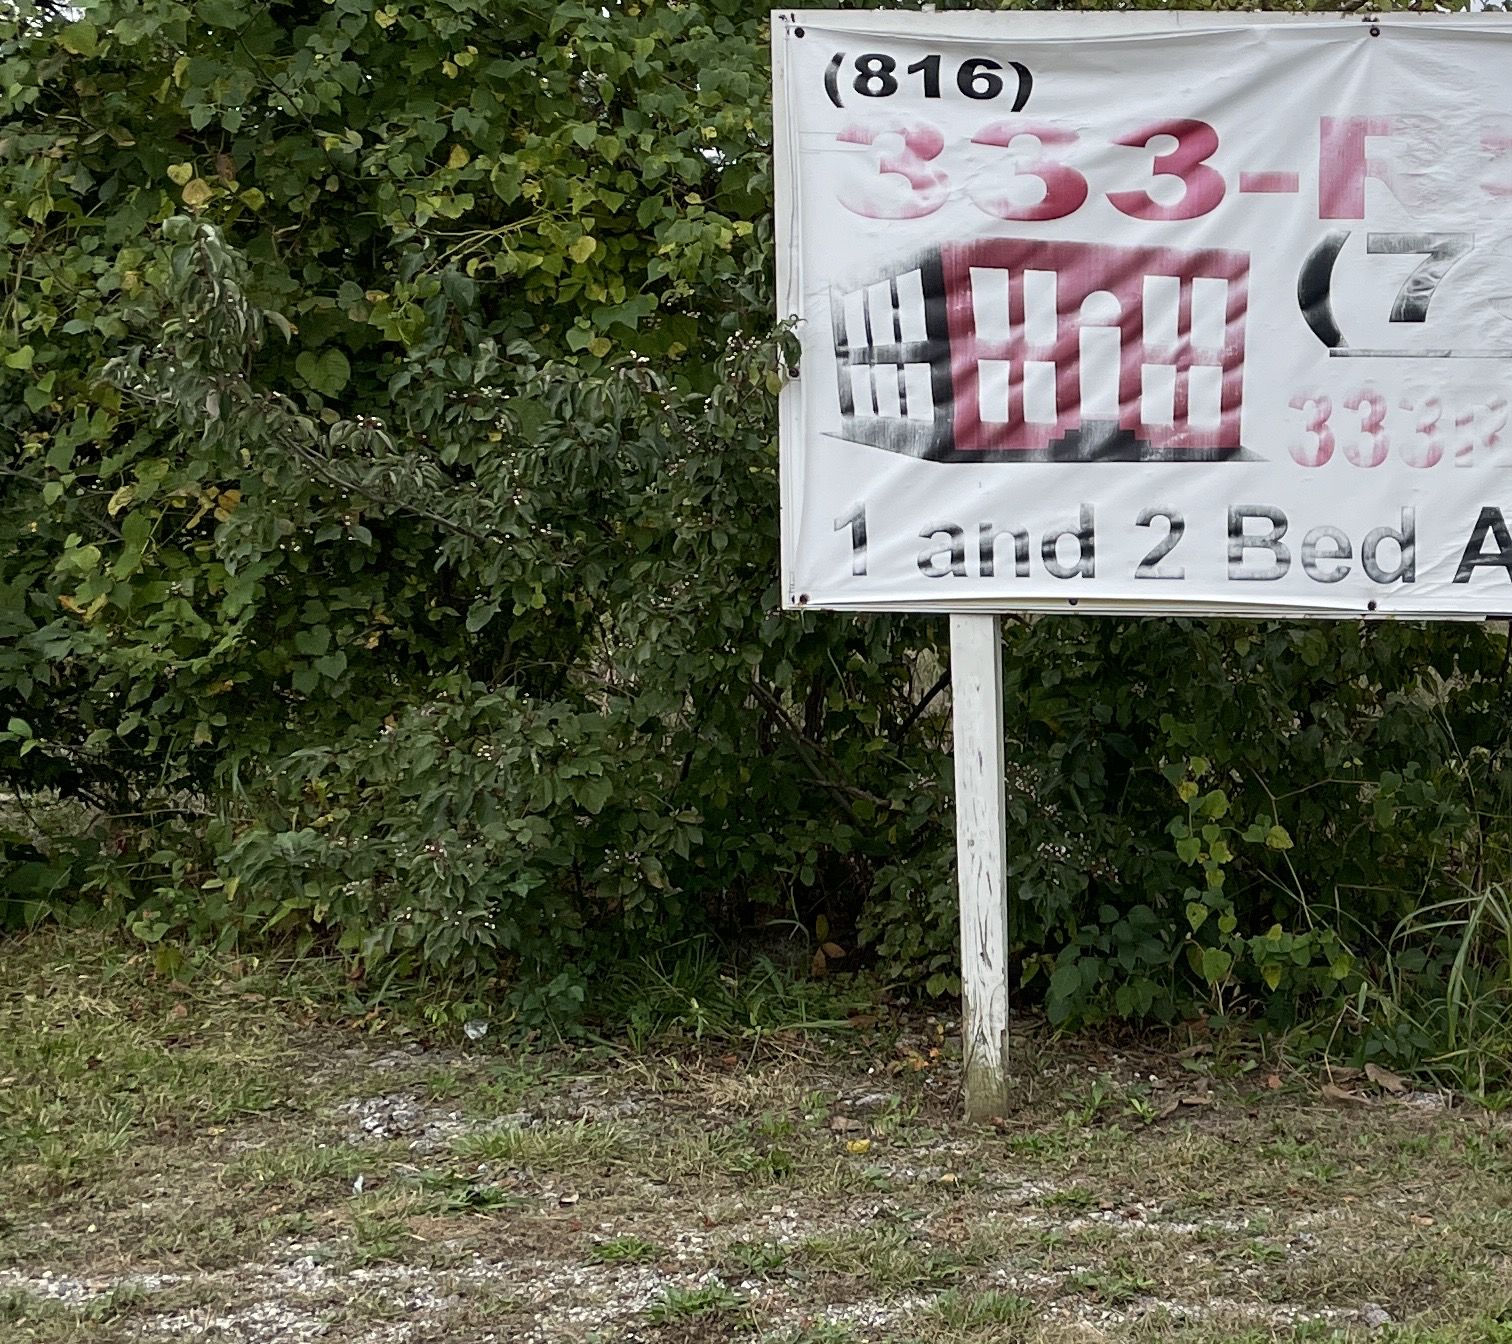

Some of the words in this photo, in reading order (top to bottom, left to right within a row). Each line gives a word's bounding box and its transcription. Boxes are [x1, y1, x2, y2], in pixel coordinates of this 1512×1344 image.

[823, 51, 1034, 113] (816)
[832, 502, 869, 578] 1
[915, 502, 1096, 579] and
[1133, 503, 1187, 581] 2
[1226, 503, 1417, 584] Bed
